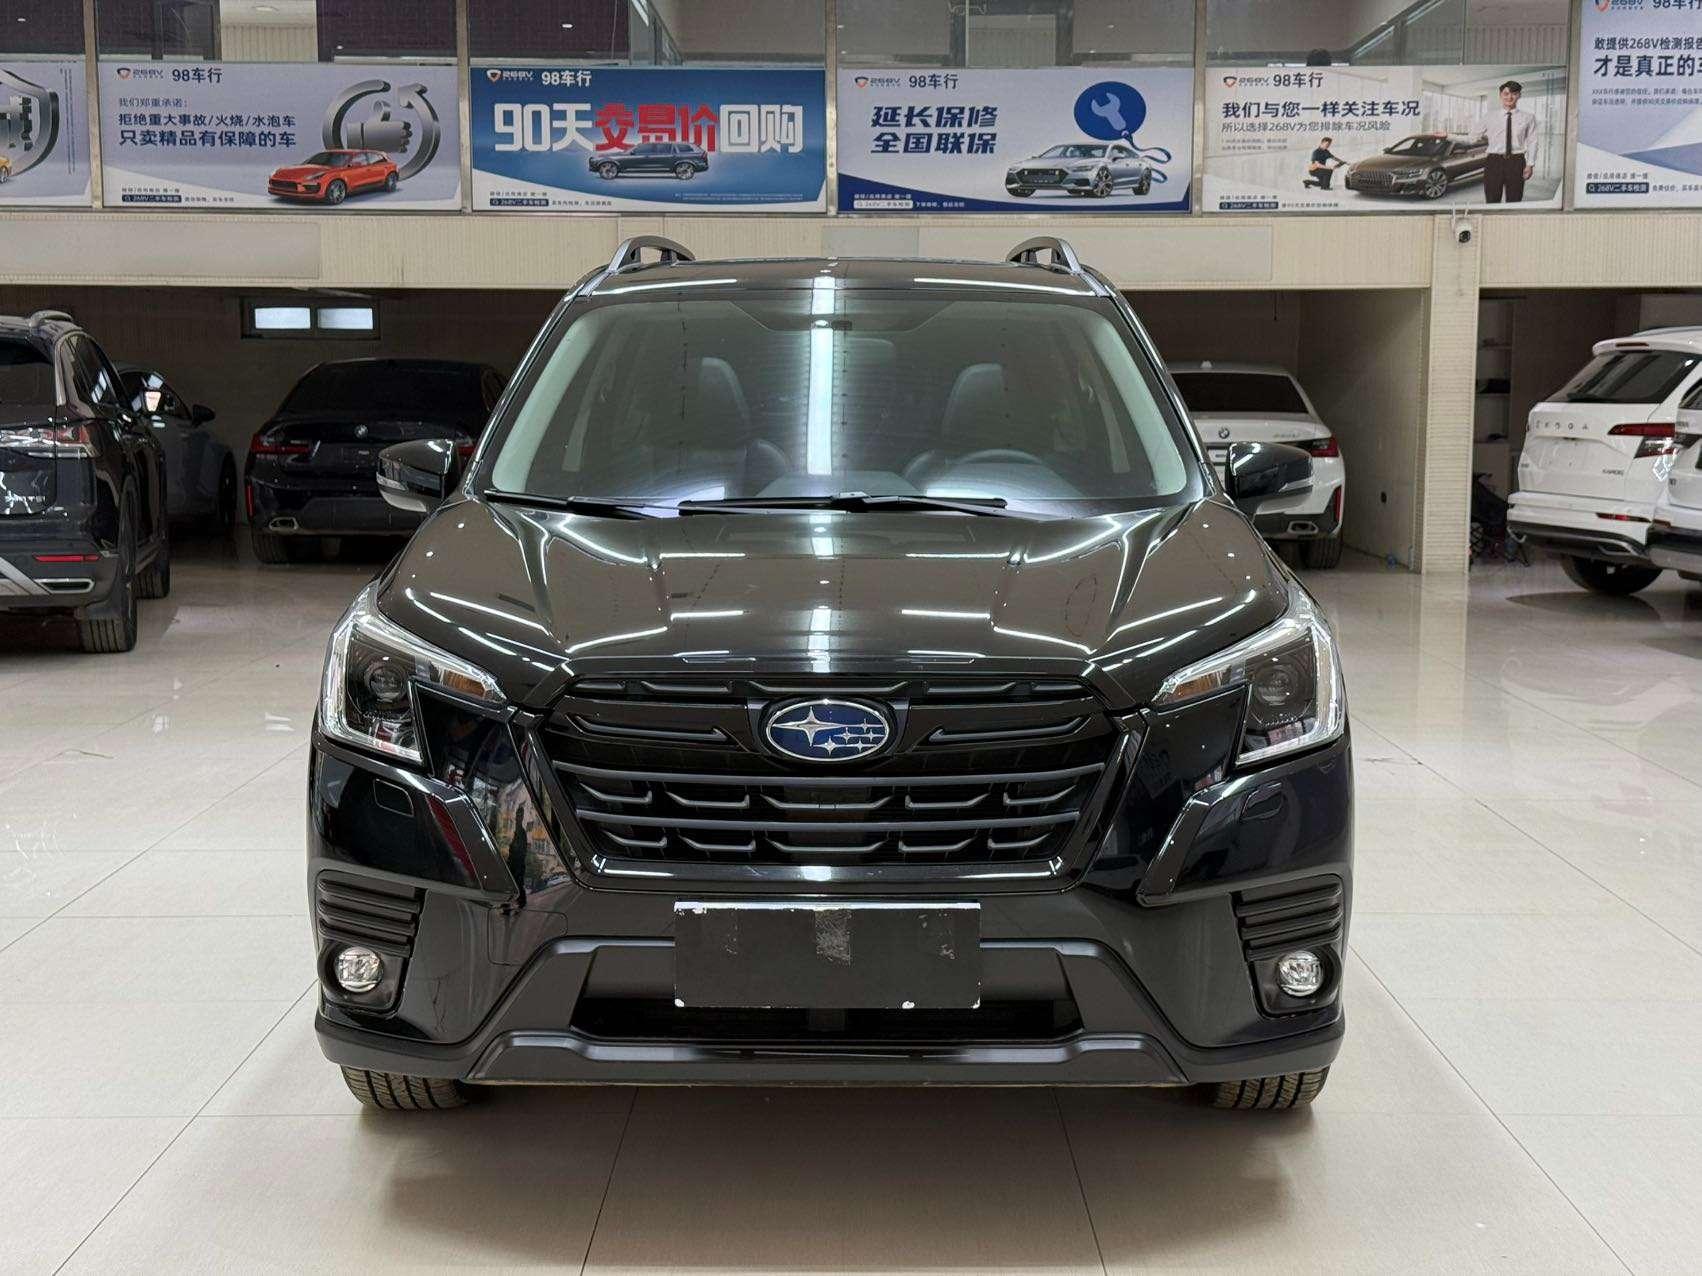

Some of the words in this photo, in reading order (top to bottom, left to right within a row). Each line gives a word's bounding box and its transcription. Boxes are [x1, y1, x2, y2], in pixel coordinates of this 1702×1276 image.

[1593, 54, 1702, 78] 才是真正的
[172, 68, 223, 84] 98车行
[541, 70, 592, 86] 98车行
[908, 73, 959, 88] 98车行
[1273, 71, 1324, 88] 98车行
[870, 105, 998, 128] 延长保修
[1222, 100, 1421, 118] 我们与您一样关注车况
[118, 113, 297, 128] 拒绝重大事故/火烧/水泡车
[494, 103, 804, 153] 90天交易价回购
[1221, 121, 1392, 132] 所以选择268V为您排除车况风险
[118, 131, 297, 149] 只卖精品有保障的车
[870, 132, 998, 154] 全国联保
